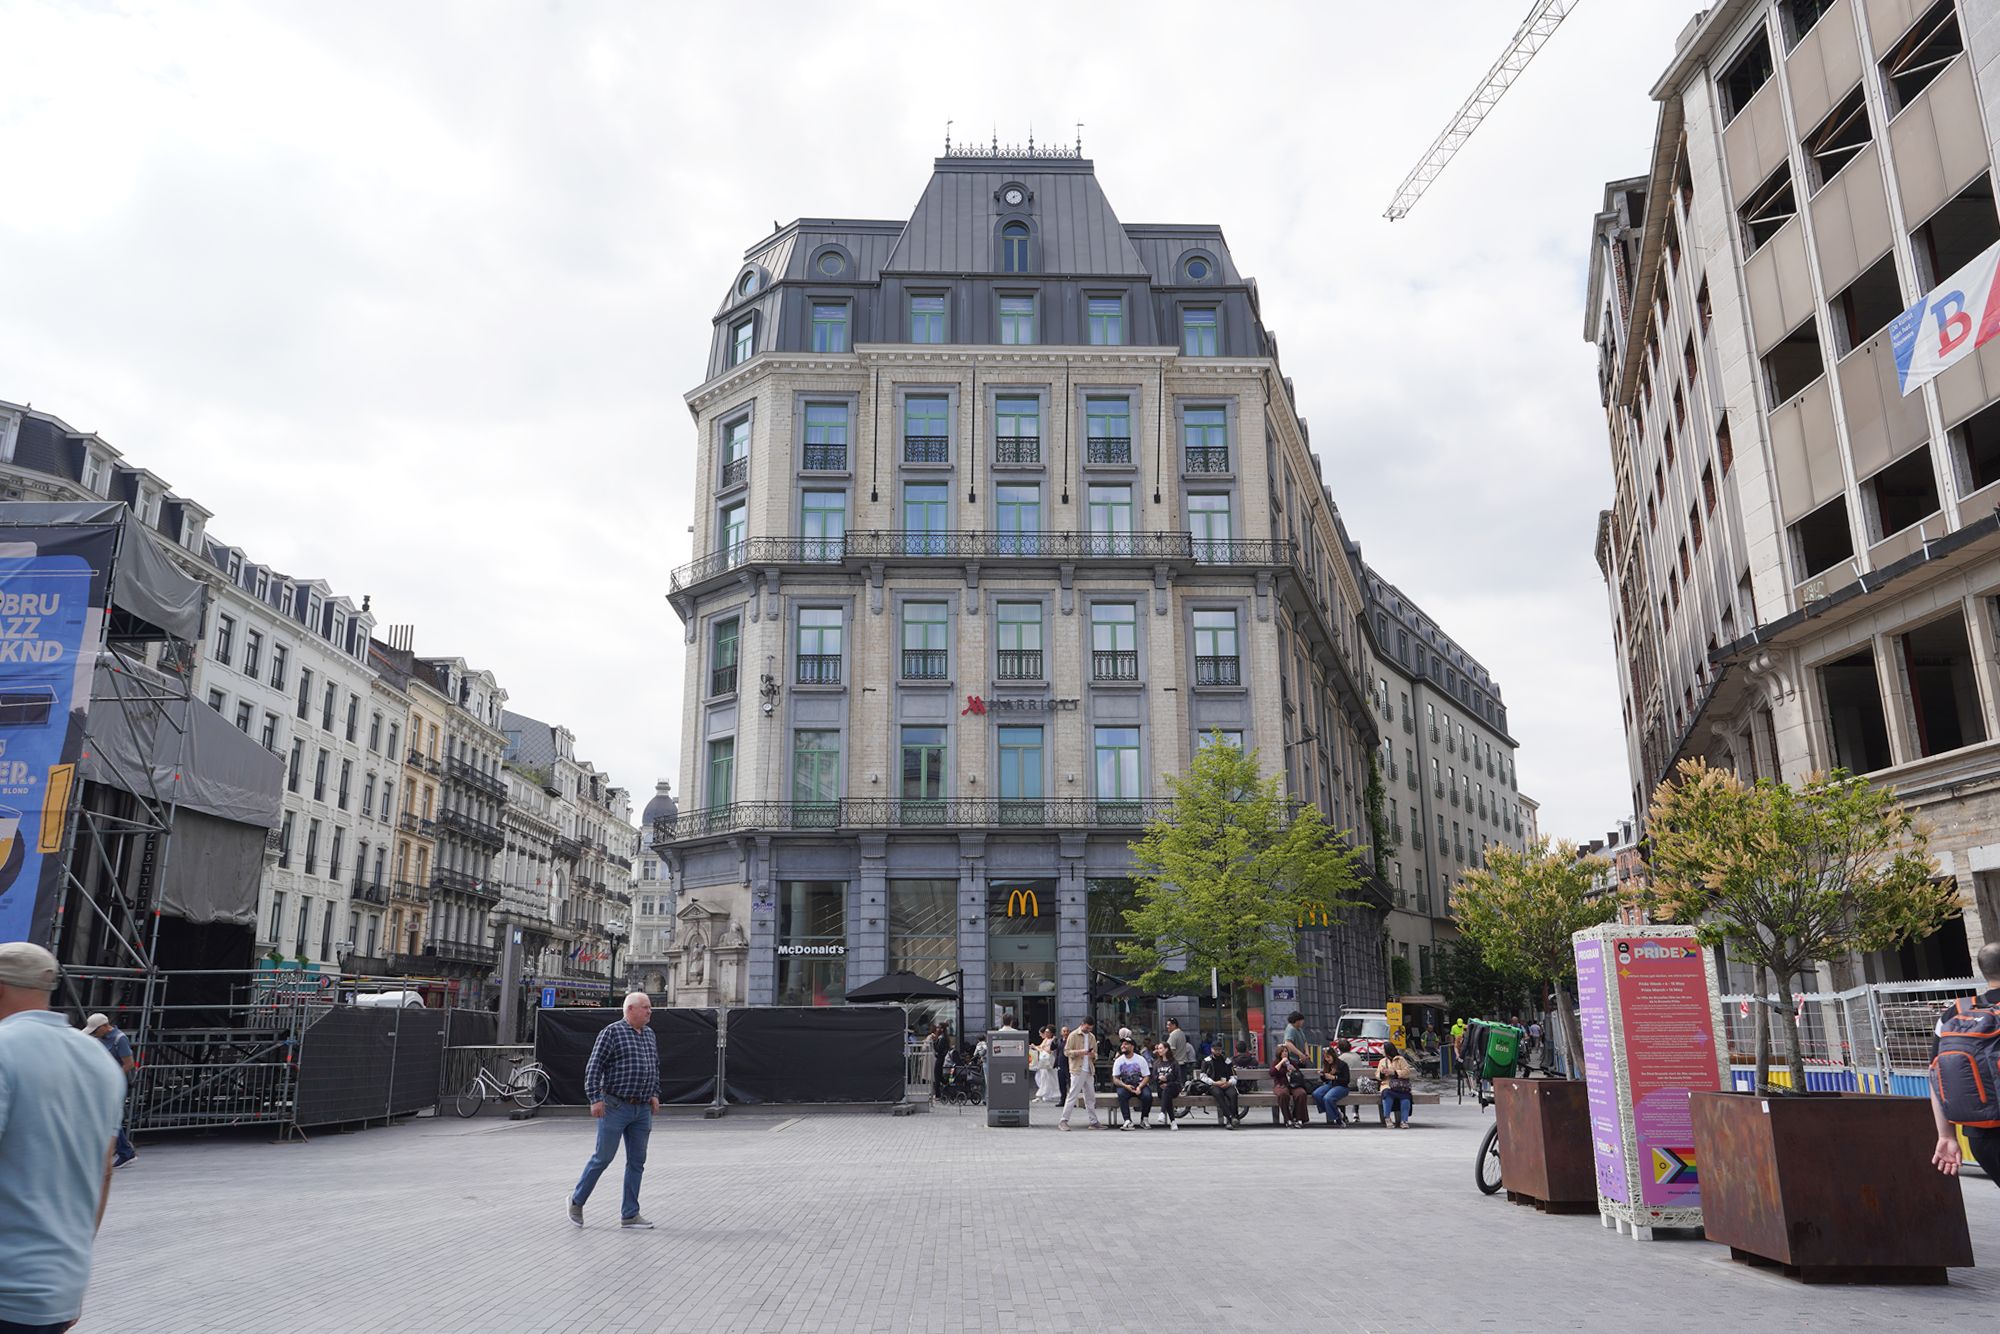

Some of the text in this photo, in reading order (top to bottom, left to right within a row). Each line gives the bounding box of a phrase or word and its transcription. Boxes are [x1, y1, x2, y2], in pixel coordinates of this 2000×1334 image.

[988, 699, 1080, 711] MARRIOTT
[2, 787, 29, 795] BLOND
[777, 945, 845, 955] McDonald's
[1634, 947, 1680, 959] PRIDE
[1495, 1043, 1509, 1053] Eats
